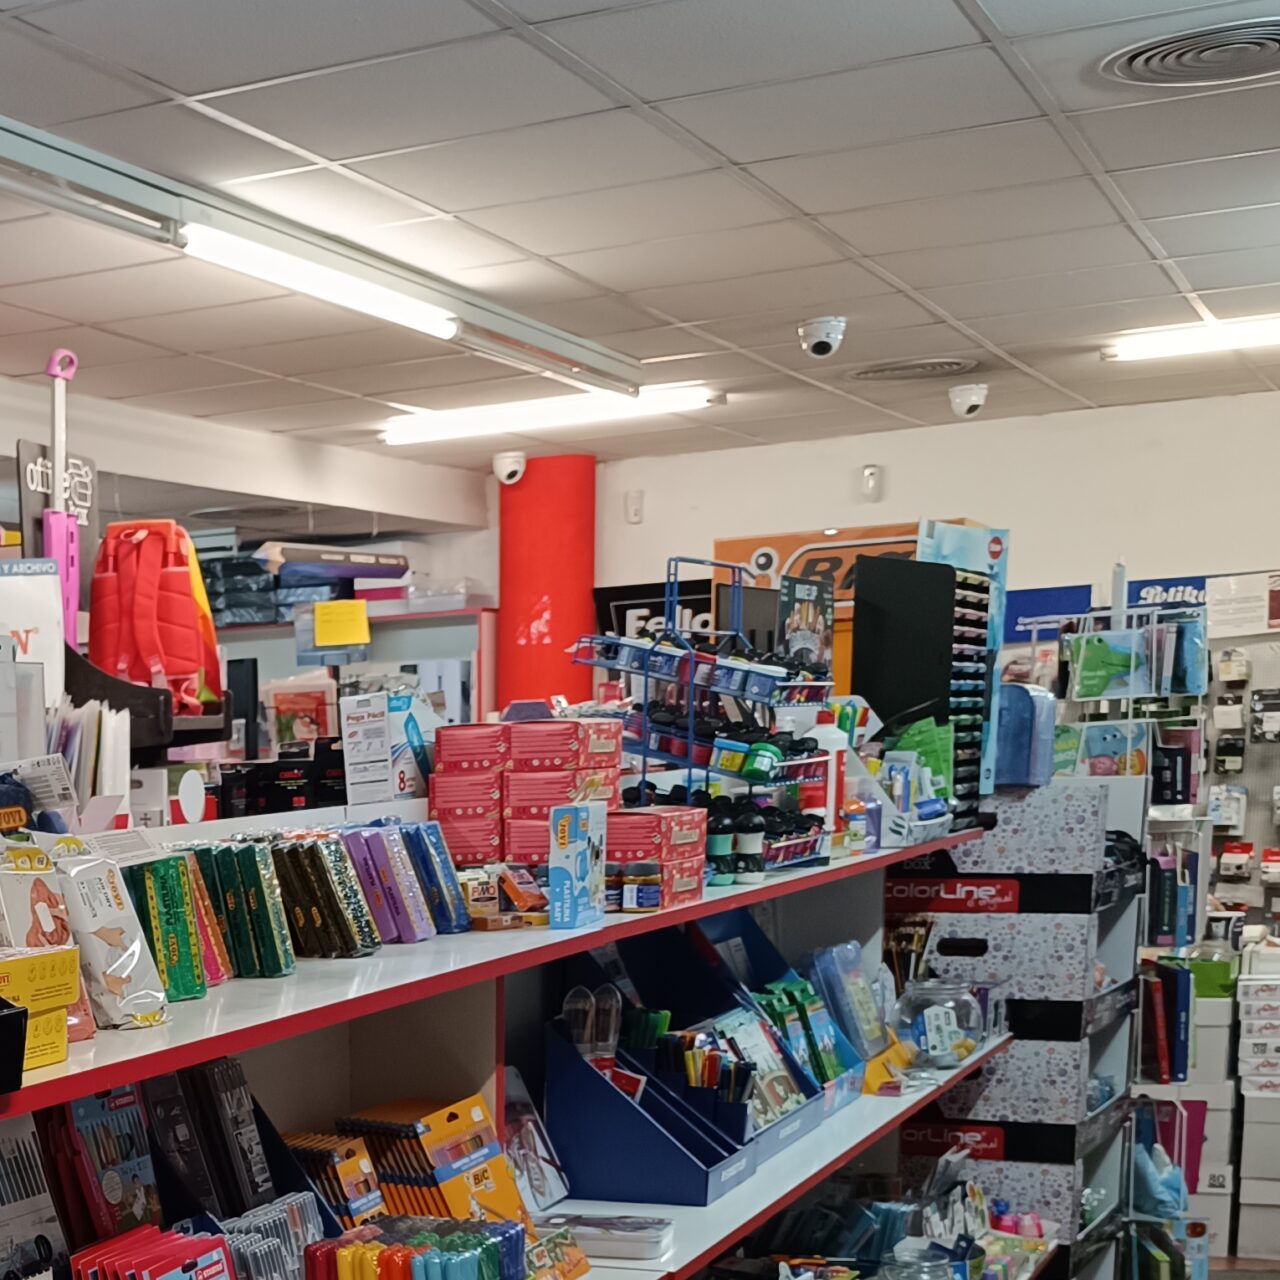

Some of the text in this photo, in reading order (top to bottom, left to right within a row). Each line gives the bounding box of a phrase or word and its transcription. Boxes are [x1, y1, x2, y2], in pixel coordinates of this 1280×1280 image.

[471, 884, 496, 897] FIMO
[885, 883, 996, 899] ColorLine
[903, 1128, 981, 1143] orLine
